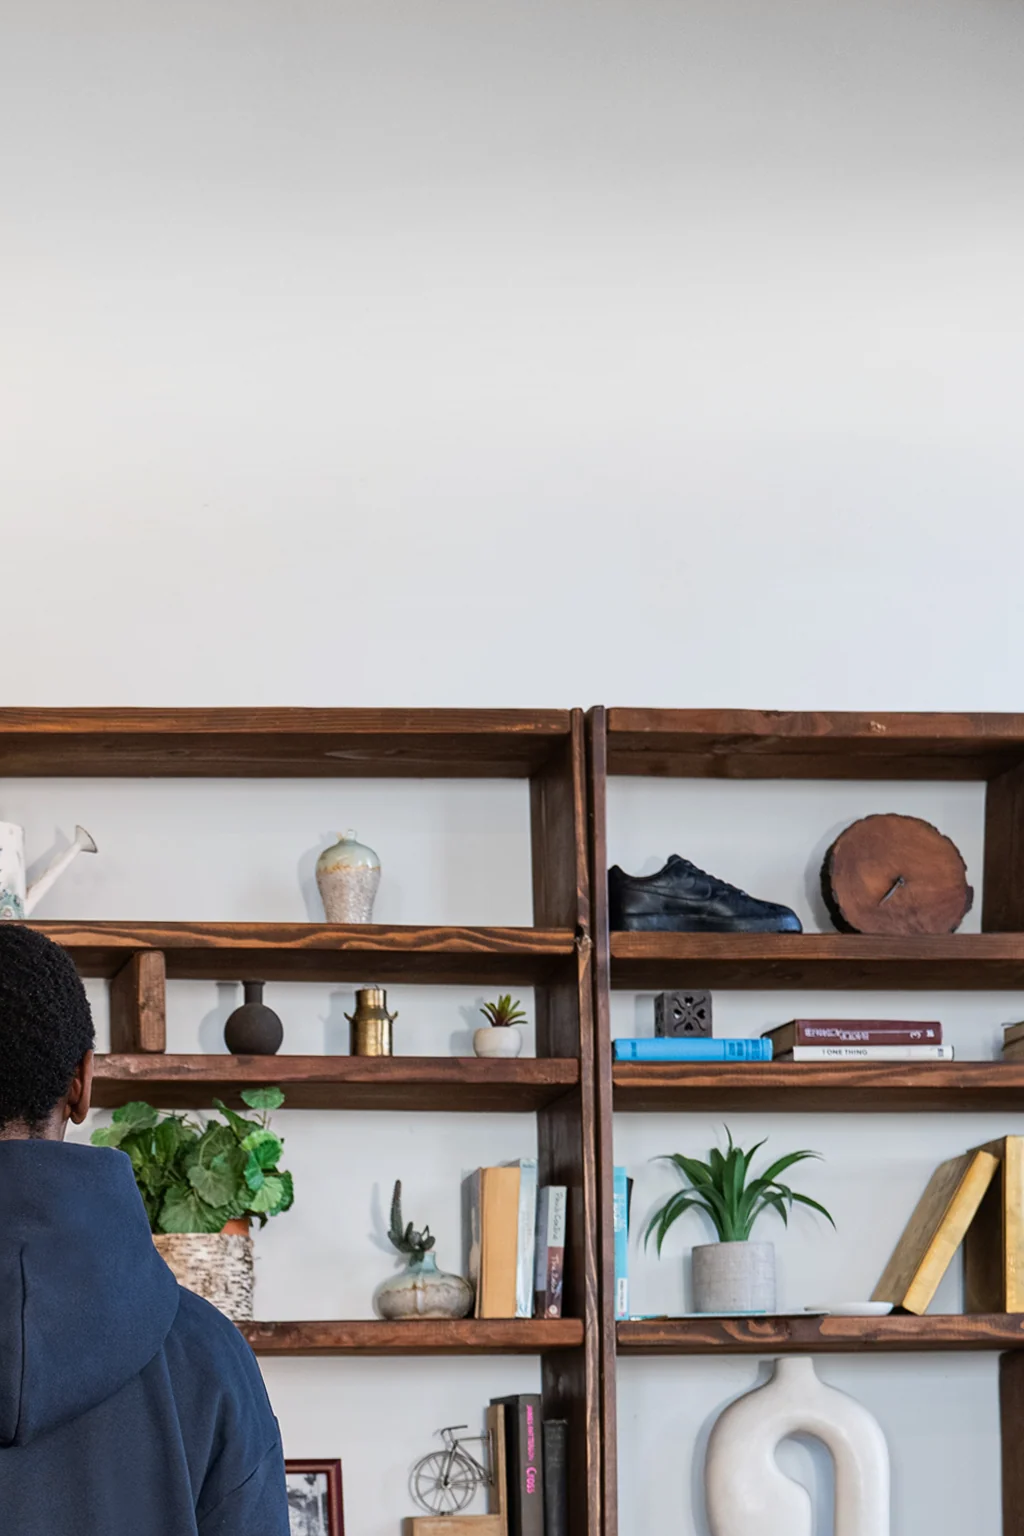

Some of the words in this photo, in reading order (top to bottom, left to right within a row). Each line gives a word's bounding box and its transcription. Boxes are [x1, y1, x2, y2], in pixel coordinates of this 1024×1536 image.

[826, 1049, 843, 1057] ONE
[845, 1049, 868, 1057] THING
[526, 1466, 537, 1494] Cross
